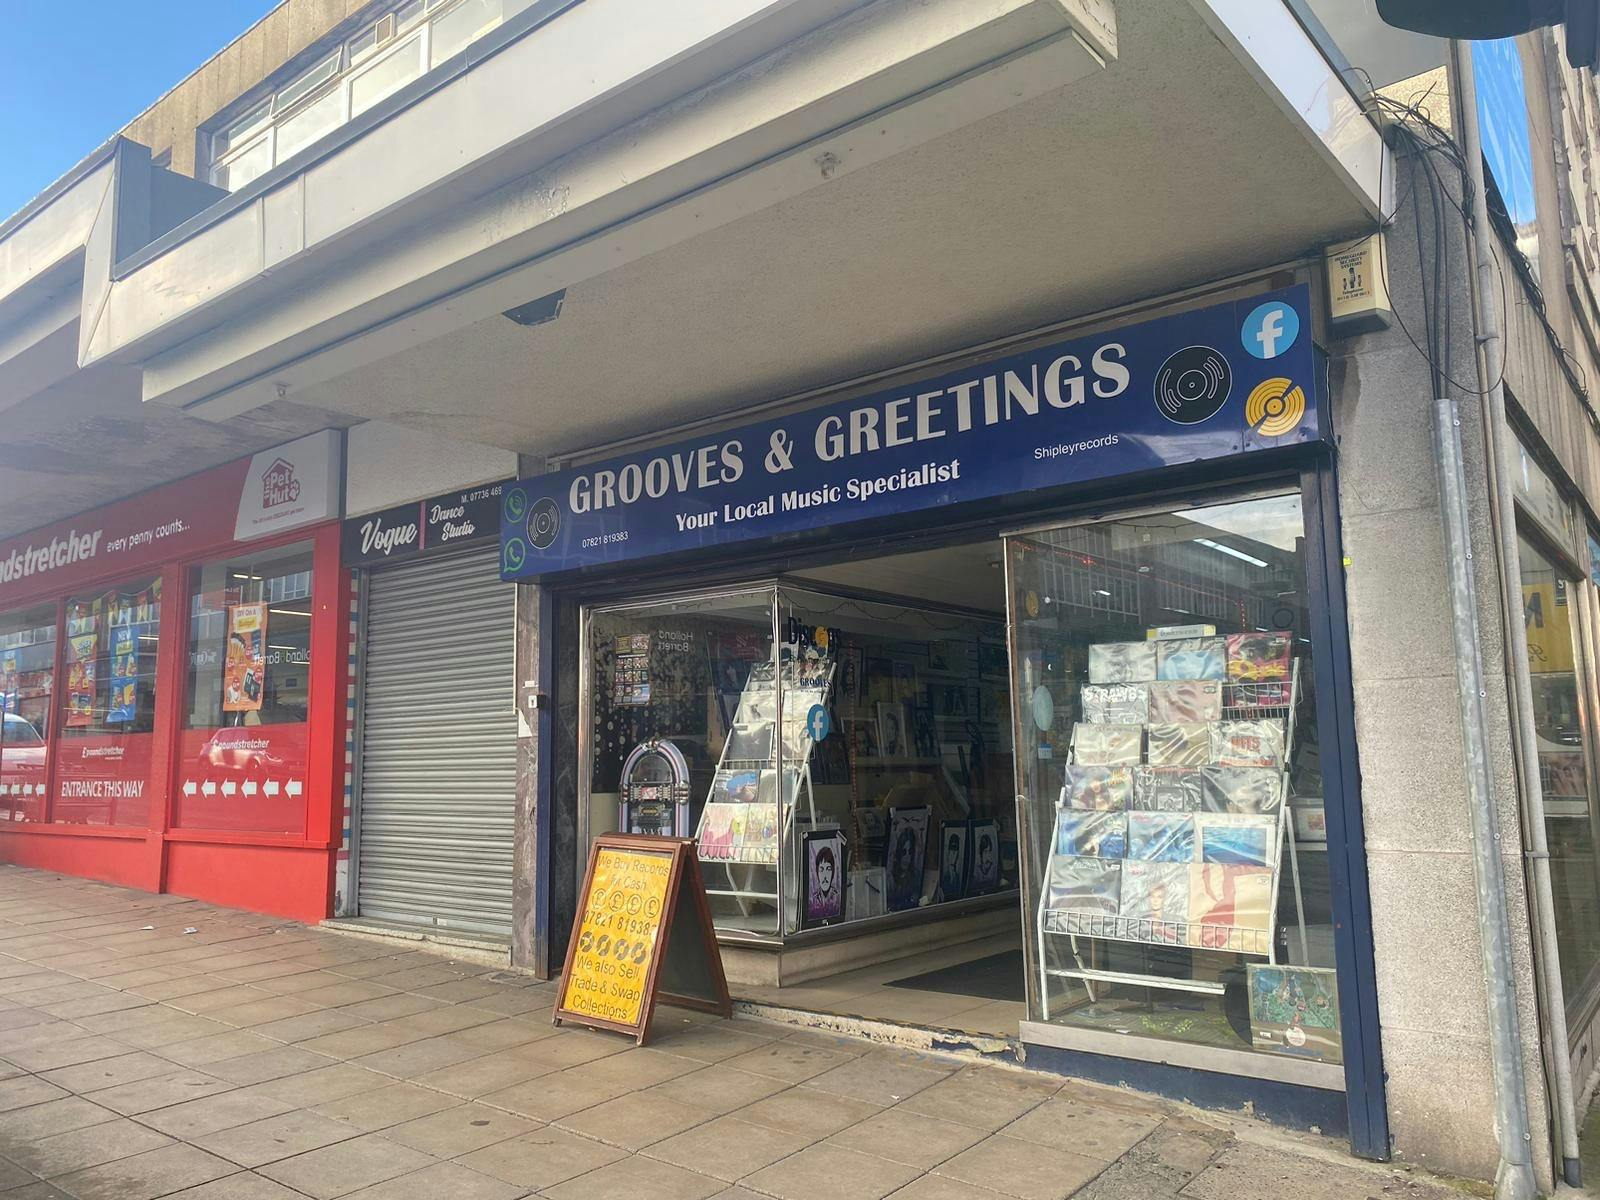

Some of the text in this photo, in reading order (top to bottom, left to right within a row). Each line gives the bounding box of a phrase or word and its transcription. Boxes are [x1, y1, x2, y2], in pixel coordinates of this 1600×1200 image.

[569, 343, 1131, 514] GROOVES & GREETINGS
[1034, 432, 1119, 460] Shipleyrecords
[270, 468, 290, 489] Pet
[269, 485, 290, 506] Hut
[469, 489, 489, 502] 07736
[676, 458, 960, 532] Your Local Music Specialist
[429, 504, 465, 524] Dance
[107, 518, 190, 552] every penny counts...
[360, 517, 418, 555] Vogue
[441, 520, 476, 542] Studio
[582, 531, 629, 549] 07821 819383
[61, 780, 144, 797] ENTRANCE THIS WAY
[599, 855, 612, 868] We
[633, 859, 669, 877] Records
[623, 875, 646, 890] Cash
[577, 955, 592, 970] We
[594, 960, 616, 976] also
[570, 973, 640, 1006] Trade & Swap
[573, 994, 628, 1019] Collections
